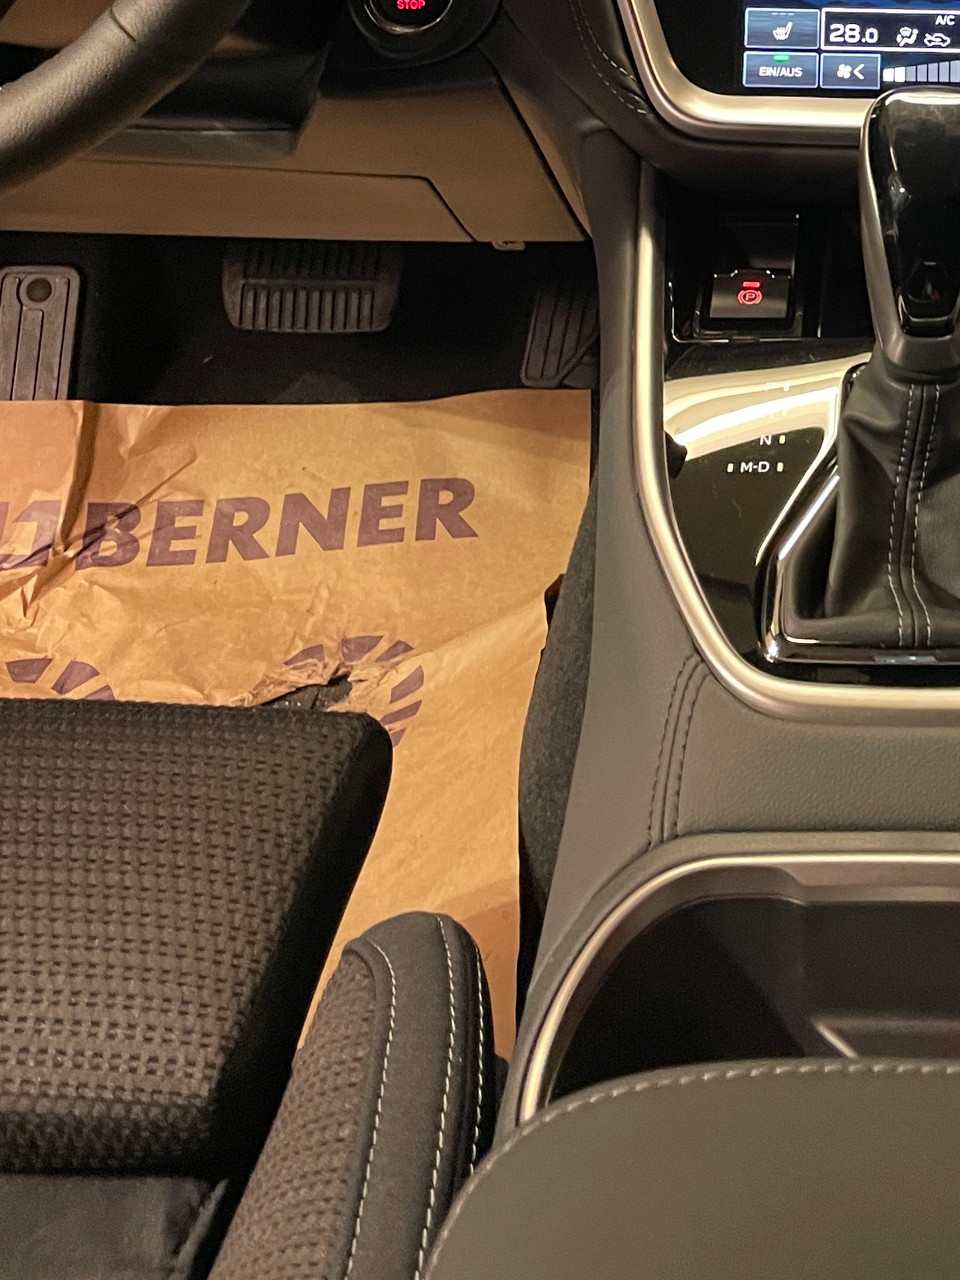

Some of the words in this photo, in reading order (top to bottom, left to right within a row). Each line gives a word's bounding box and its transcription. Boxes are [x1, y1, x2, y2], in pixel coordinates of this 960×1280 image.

[396, 0, 426, 10] STOP
[936, 15, 955, 26] A/C
[830, 24, 878, 43] 28.0
[759, 67, 803, 78] EIN/AUS
[760, 434, 772, 446] N
[740, 461, 770, 473] M-D
[75, 477, 479, 570] BERNER
